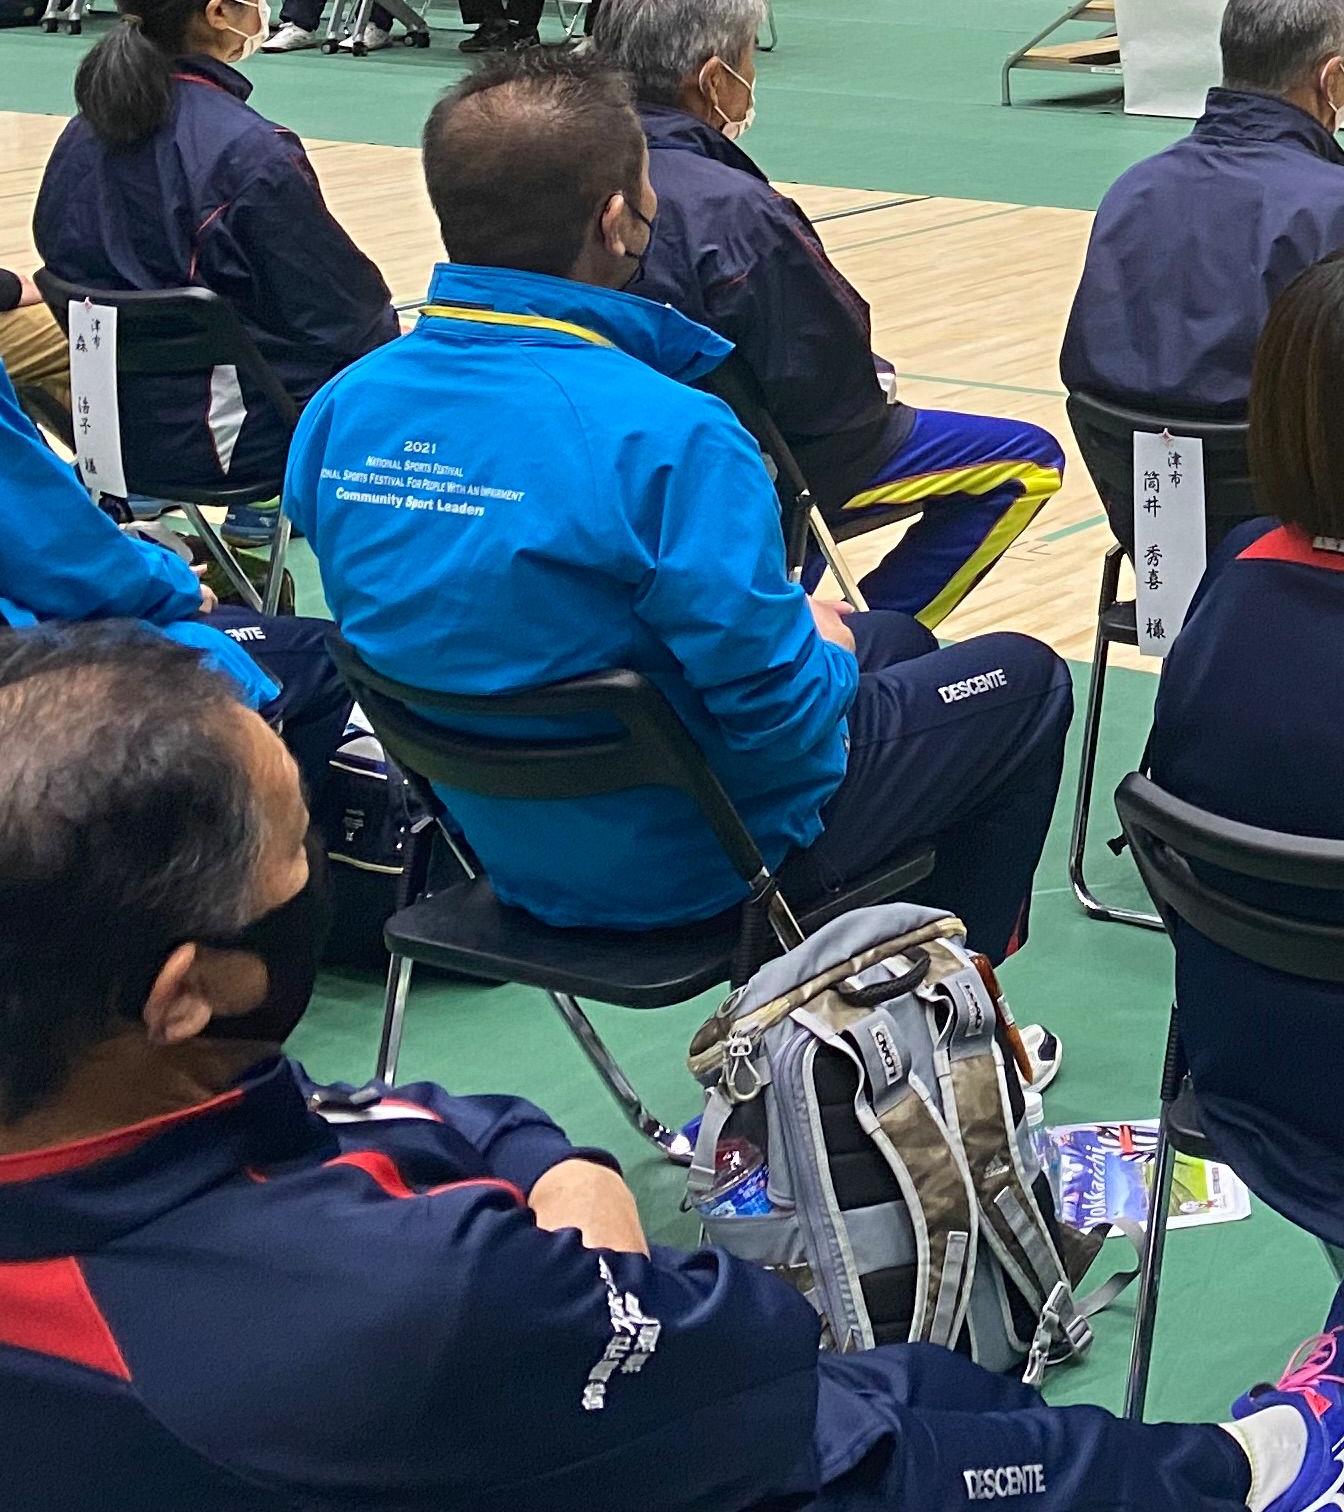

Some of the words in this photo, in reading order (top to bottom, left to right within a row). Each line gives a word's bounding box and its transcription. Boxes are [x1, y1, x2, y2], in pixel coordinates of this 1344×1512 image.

[404, 440, 436, 454] 2021
[1167, 451, 1183, 488] 津市
[336, 487, 403, 508] Community
[405, 495, 434, 512] Sport
[437, 499, 485, 517] Leaders
[938, 668, 1007, 703] DESCENTE
[963, 1464, 1046, 1500] DESCENTE
